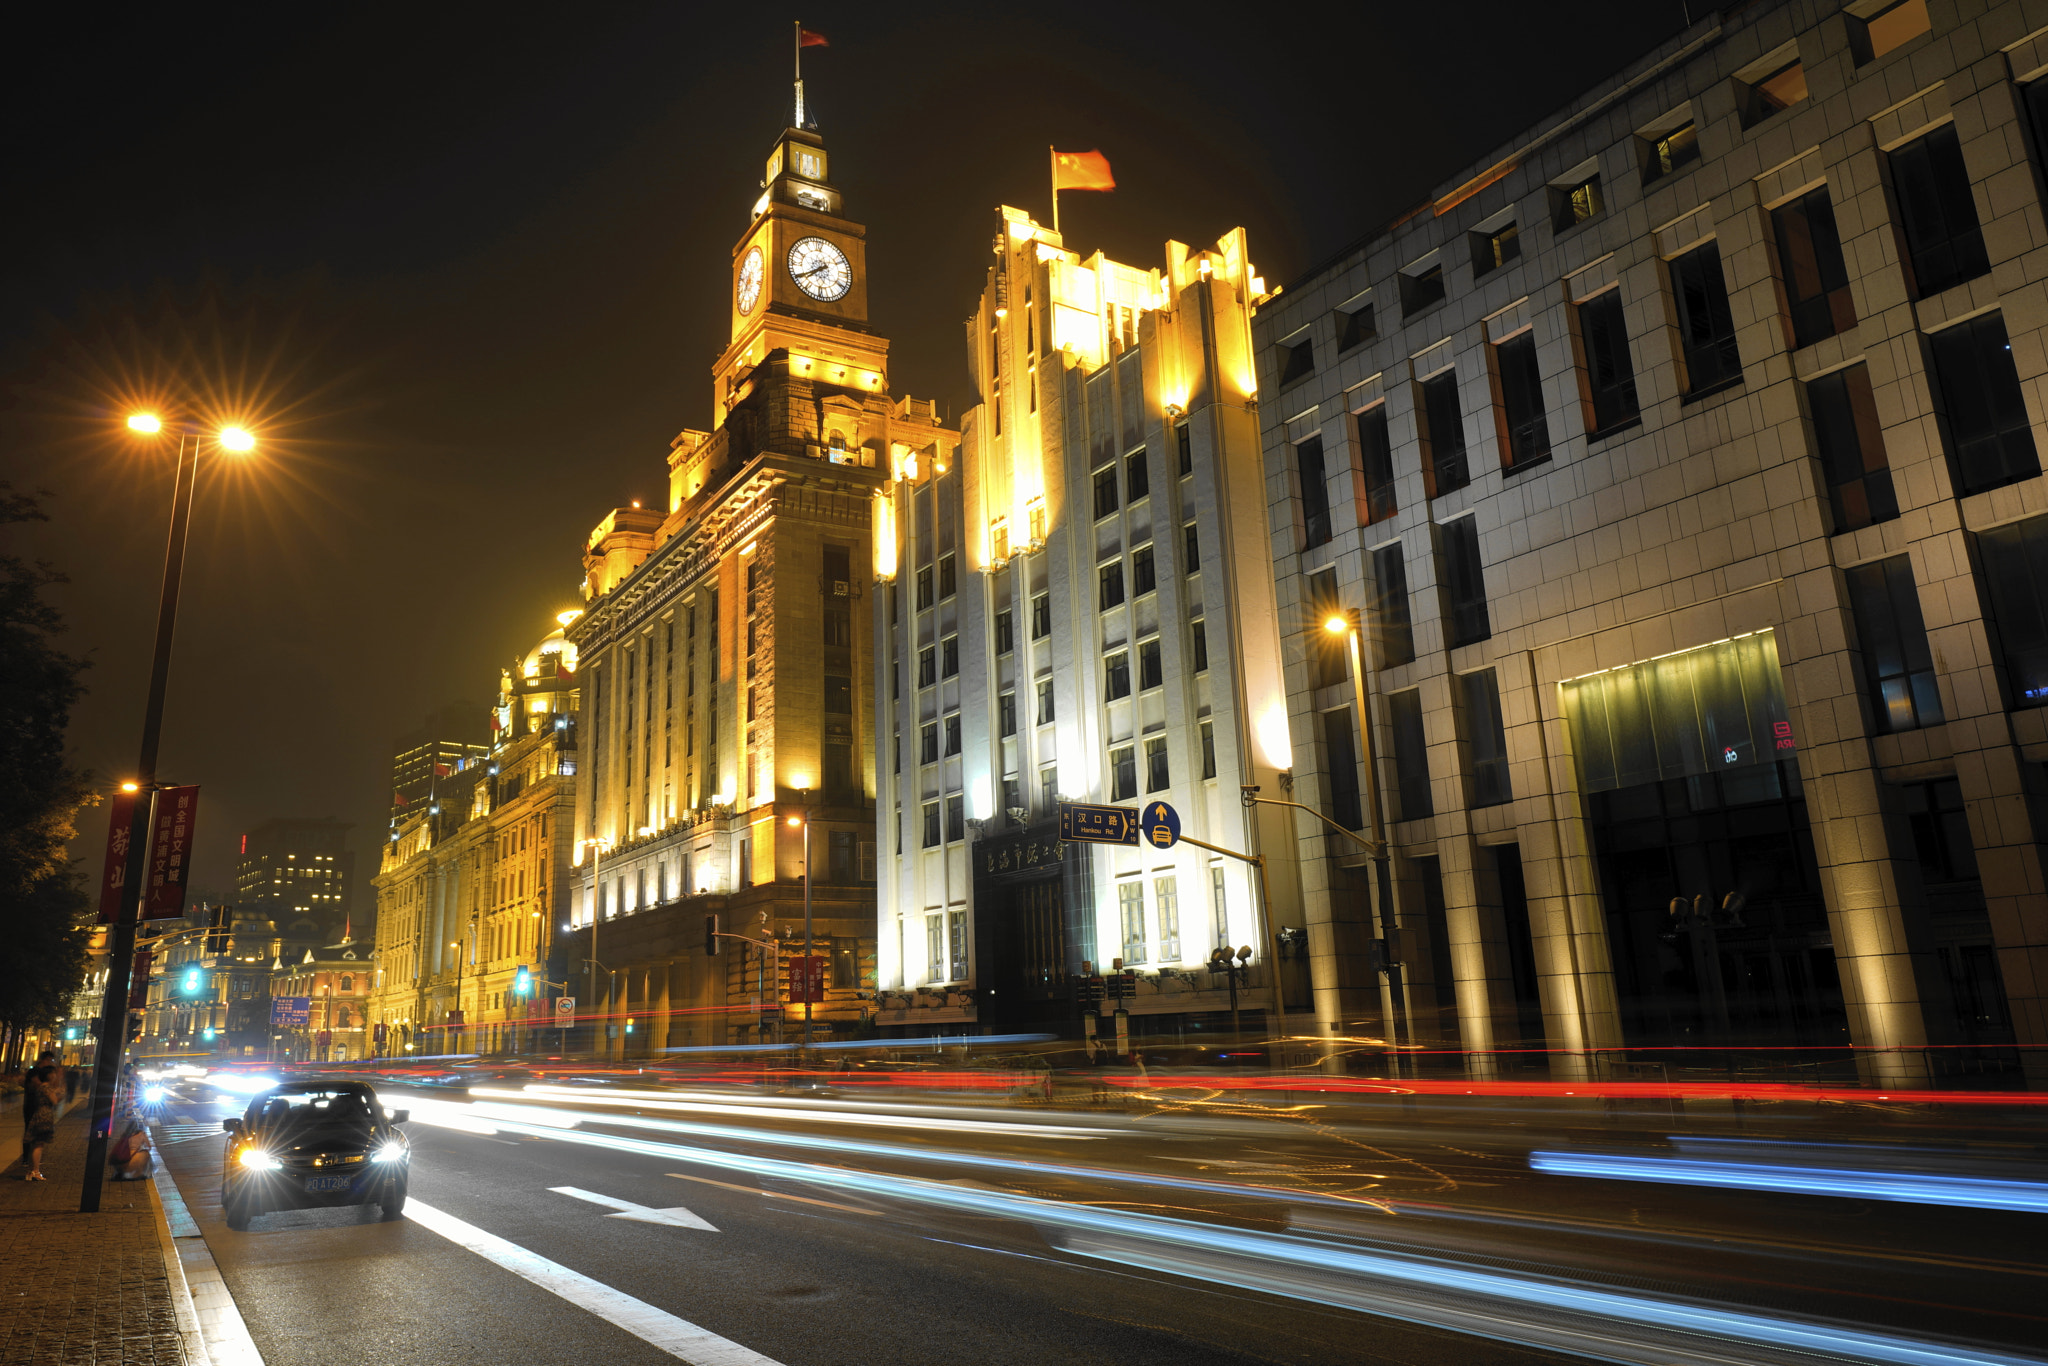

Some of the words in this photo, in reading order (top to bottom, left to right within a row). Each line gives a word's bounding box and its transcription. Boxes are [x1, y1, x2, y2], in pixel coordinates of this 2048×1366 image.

[169, 796, 188, 882] 创全国文明城
[1078, 813, 1117, 826] 汉口路
